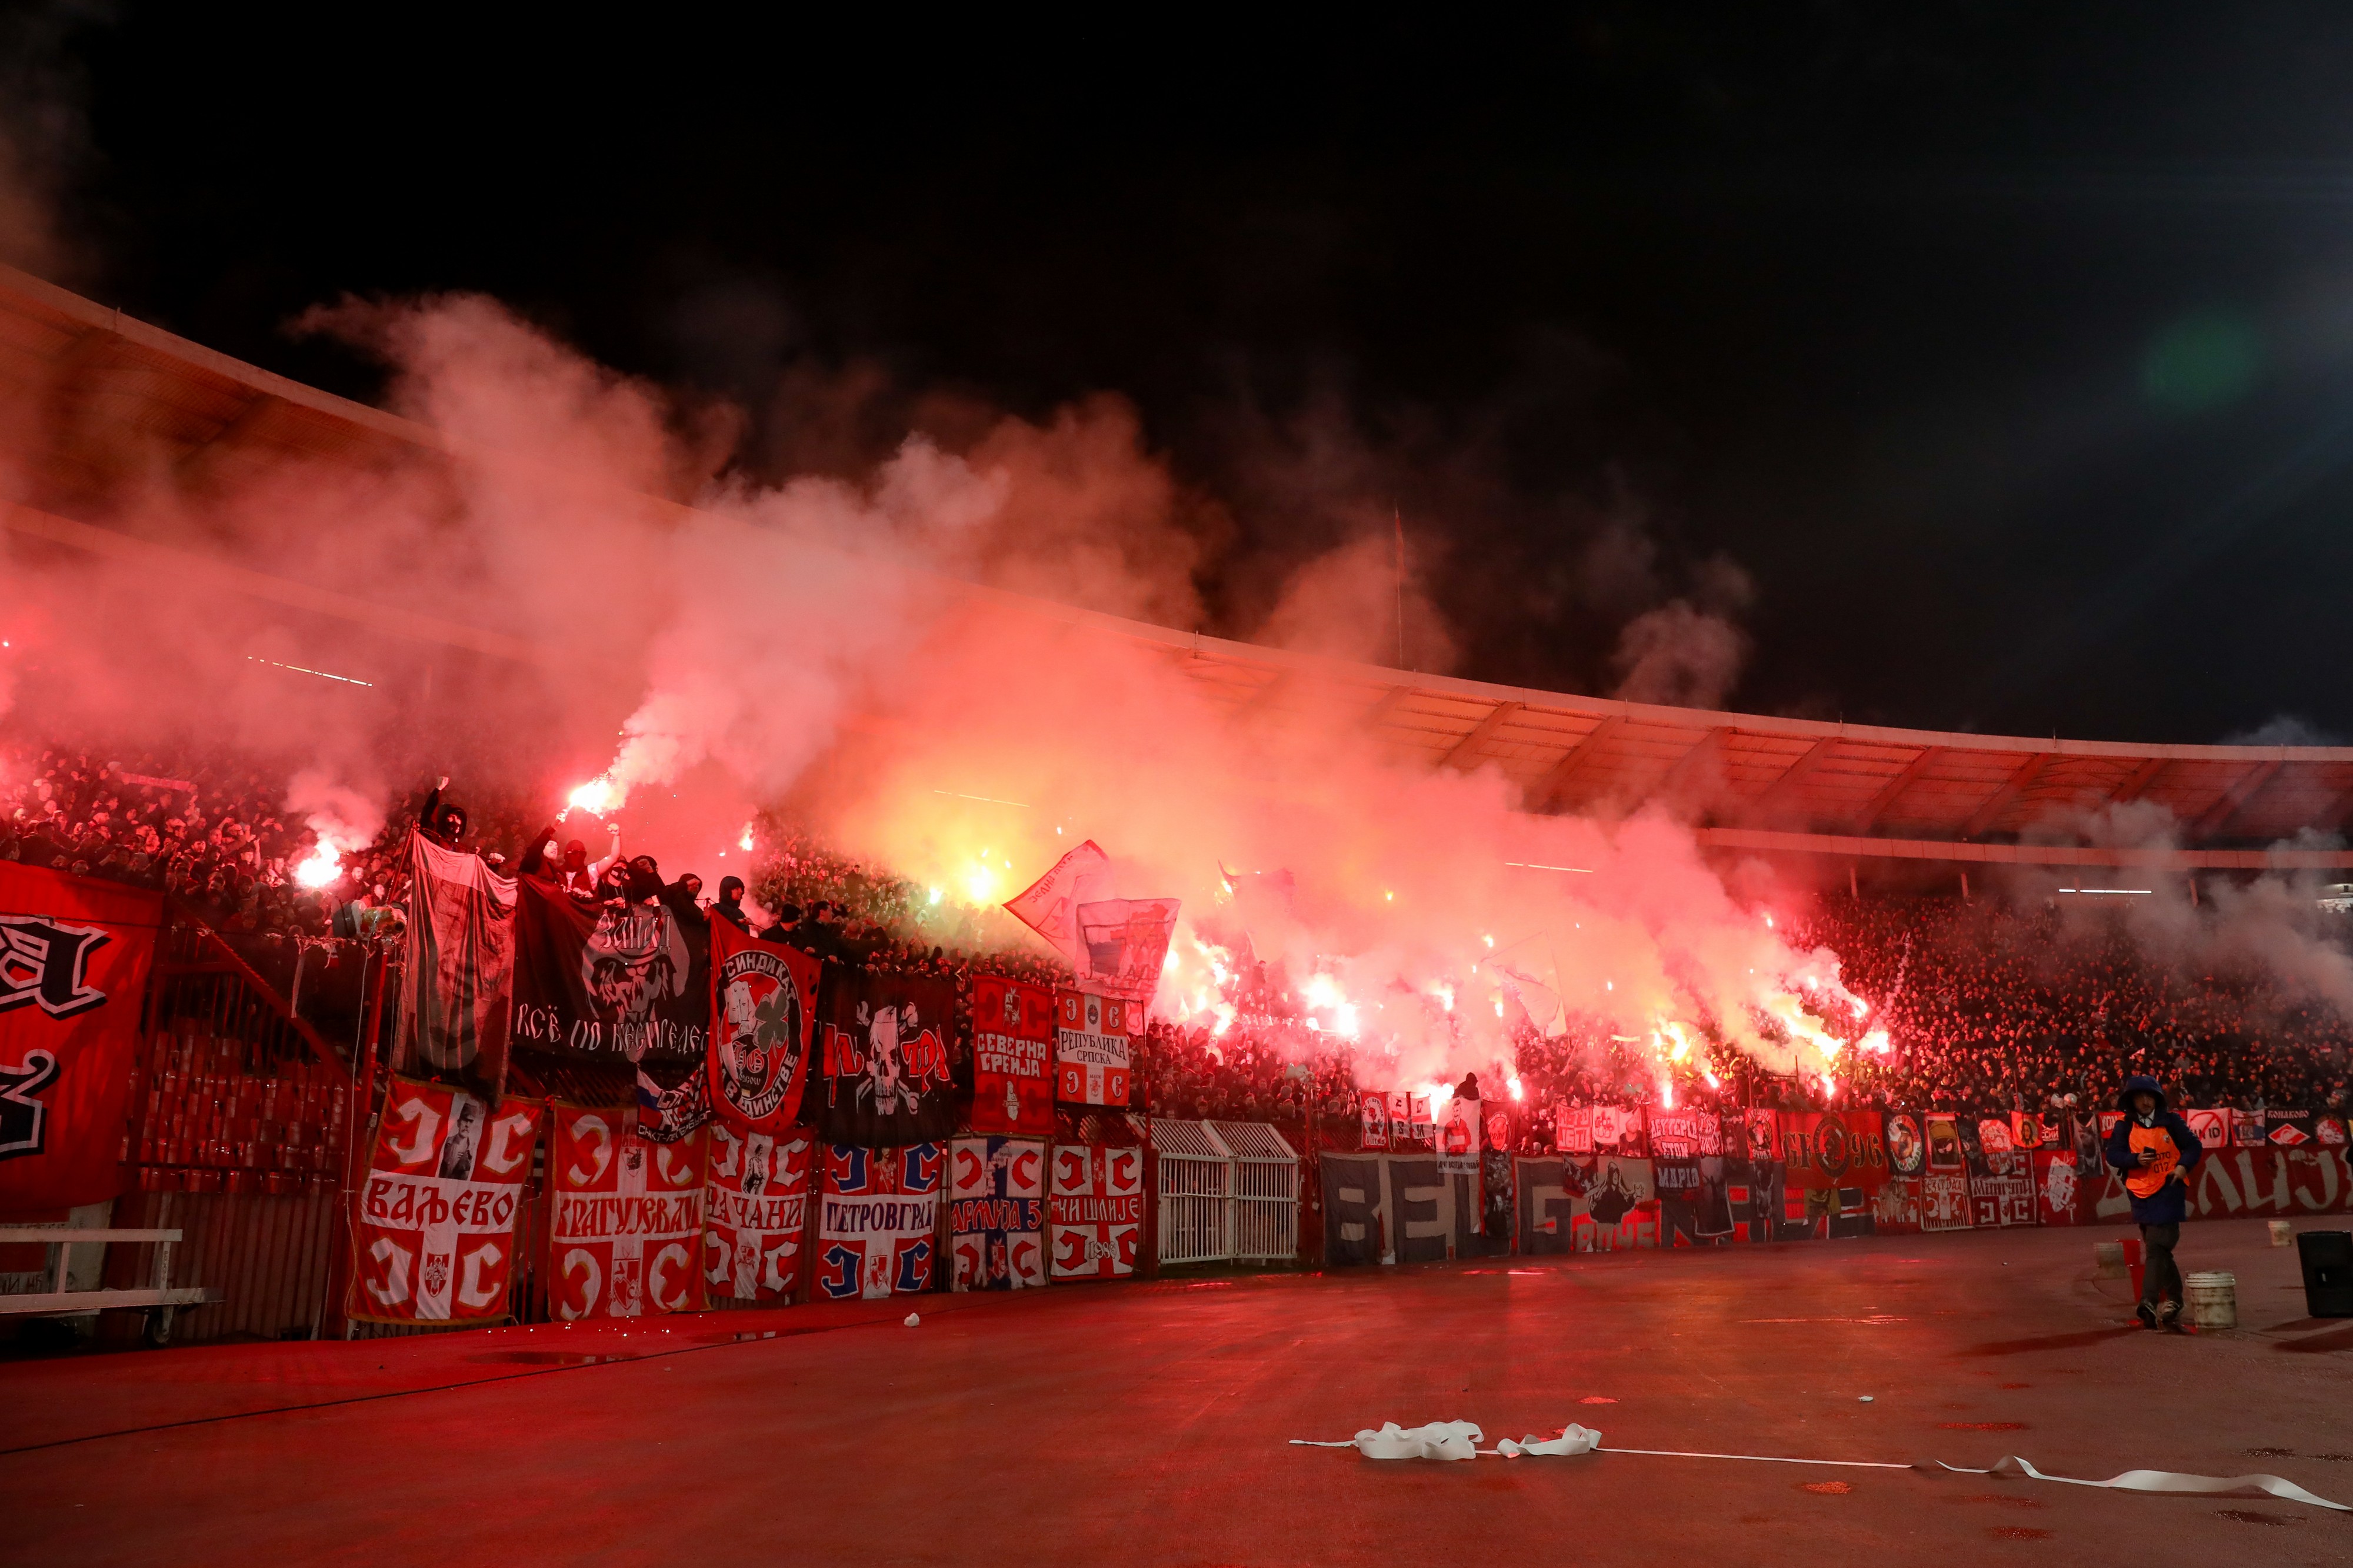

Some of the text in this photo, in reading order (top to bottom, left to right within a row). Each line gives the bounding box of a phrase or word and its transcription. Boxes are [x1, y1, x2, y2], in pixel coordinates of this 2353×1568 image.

[725, 953, 797, 1000] СИНДИКАТ
[976, 1033, 1046, 1061] СЕВЕРНА
[1060, 1031, 1126, 1061] РЕПУБЛИКА
[1076, 1050, 1112, 1065] СРПСКА
[2267, 1110, 2309, 1119] КОНАКОВО
[2209, 1127, 2221, 1139] ID
[1851, 1133, 1883, 1168] 96
[2156, 1151, 2171, 1161] OTO
[2153, 1162, 2169, 1173] 012
[367, 1178, 514, 1231] ВАЉЕВО
[951, 1199, 1042, 1233] АРМИЈА 5
